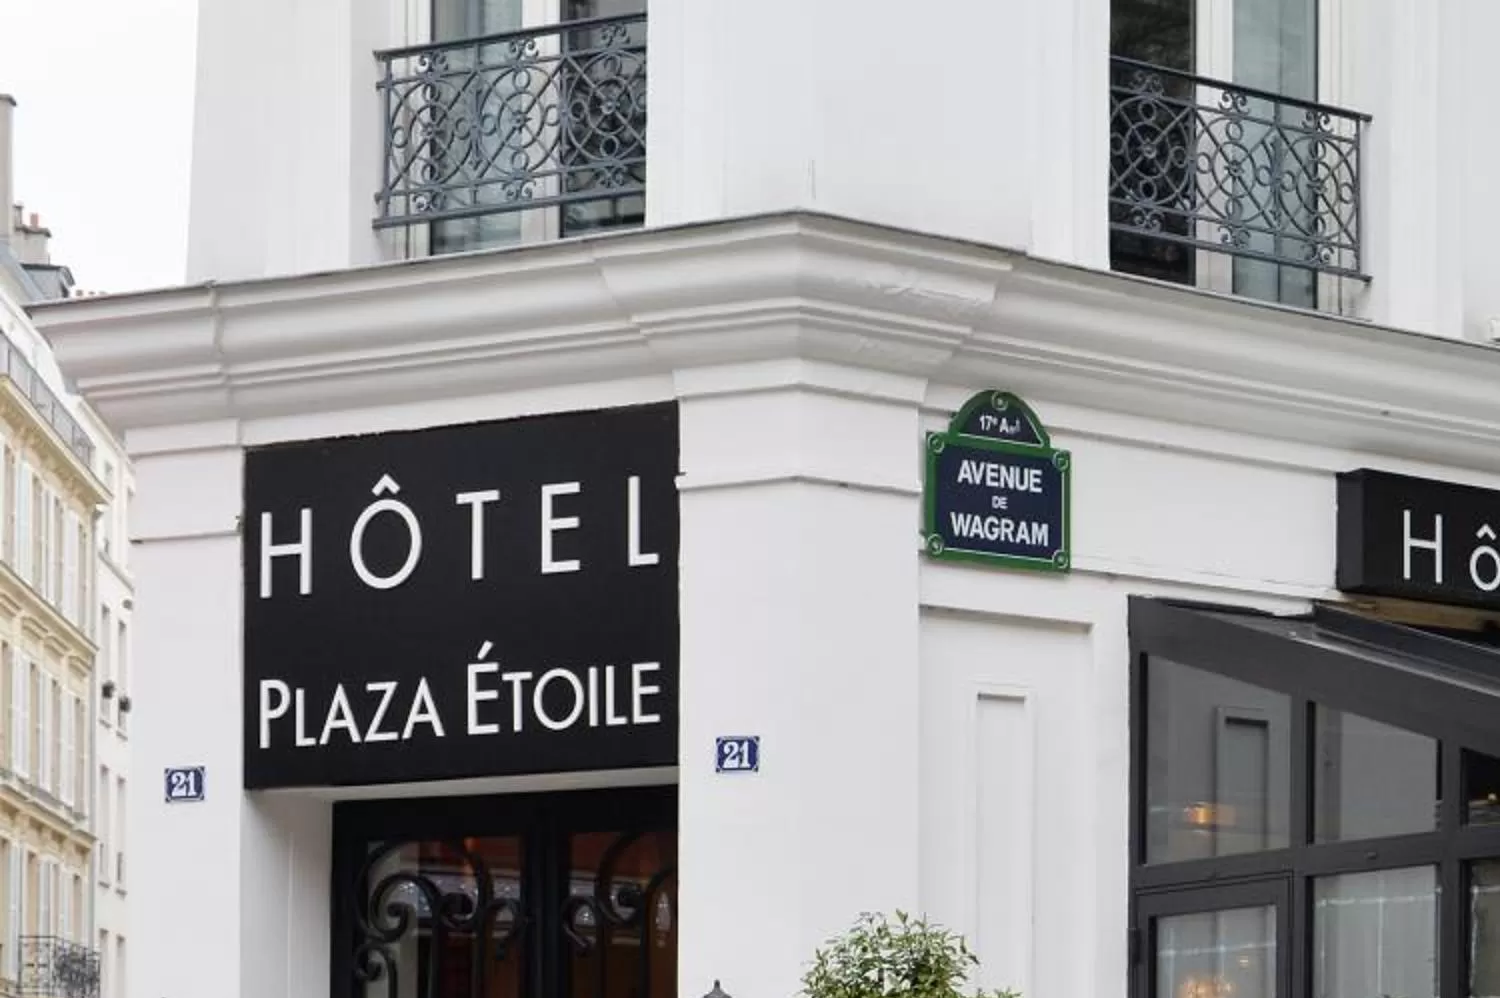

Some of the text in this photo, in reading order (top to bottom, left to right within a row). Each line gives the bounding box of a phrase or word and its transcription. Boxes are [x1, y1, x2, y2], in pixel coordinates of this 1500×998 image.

[956, 459, 1043, 493] AVENUE
[991, 495, 1008, 509] DE
[260, 473, 660, 599] HÔTEL
[949, 511, 1049, 547] WAGRAM
[259, 640, 662, 749] PLAZA ÉTOILE
[722, 740, 751, 769] 21
[171, 771, 198, 797] 21
